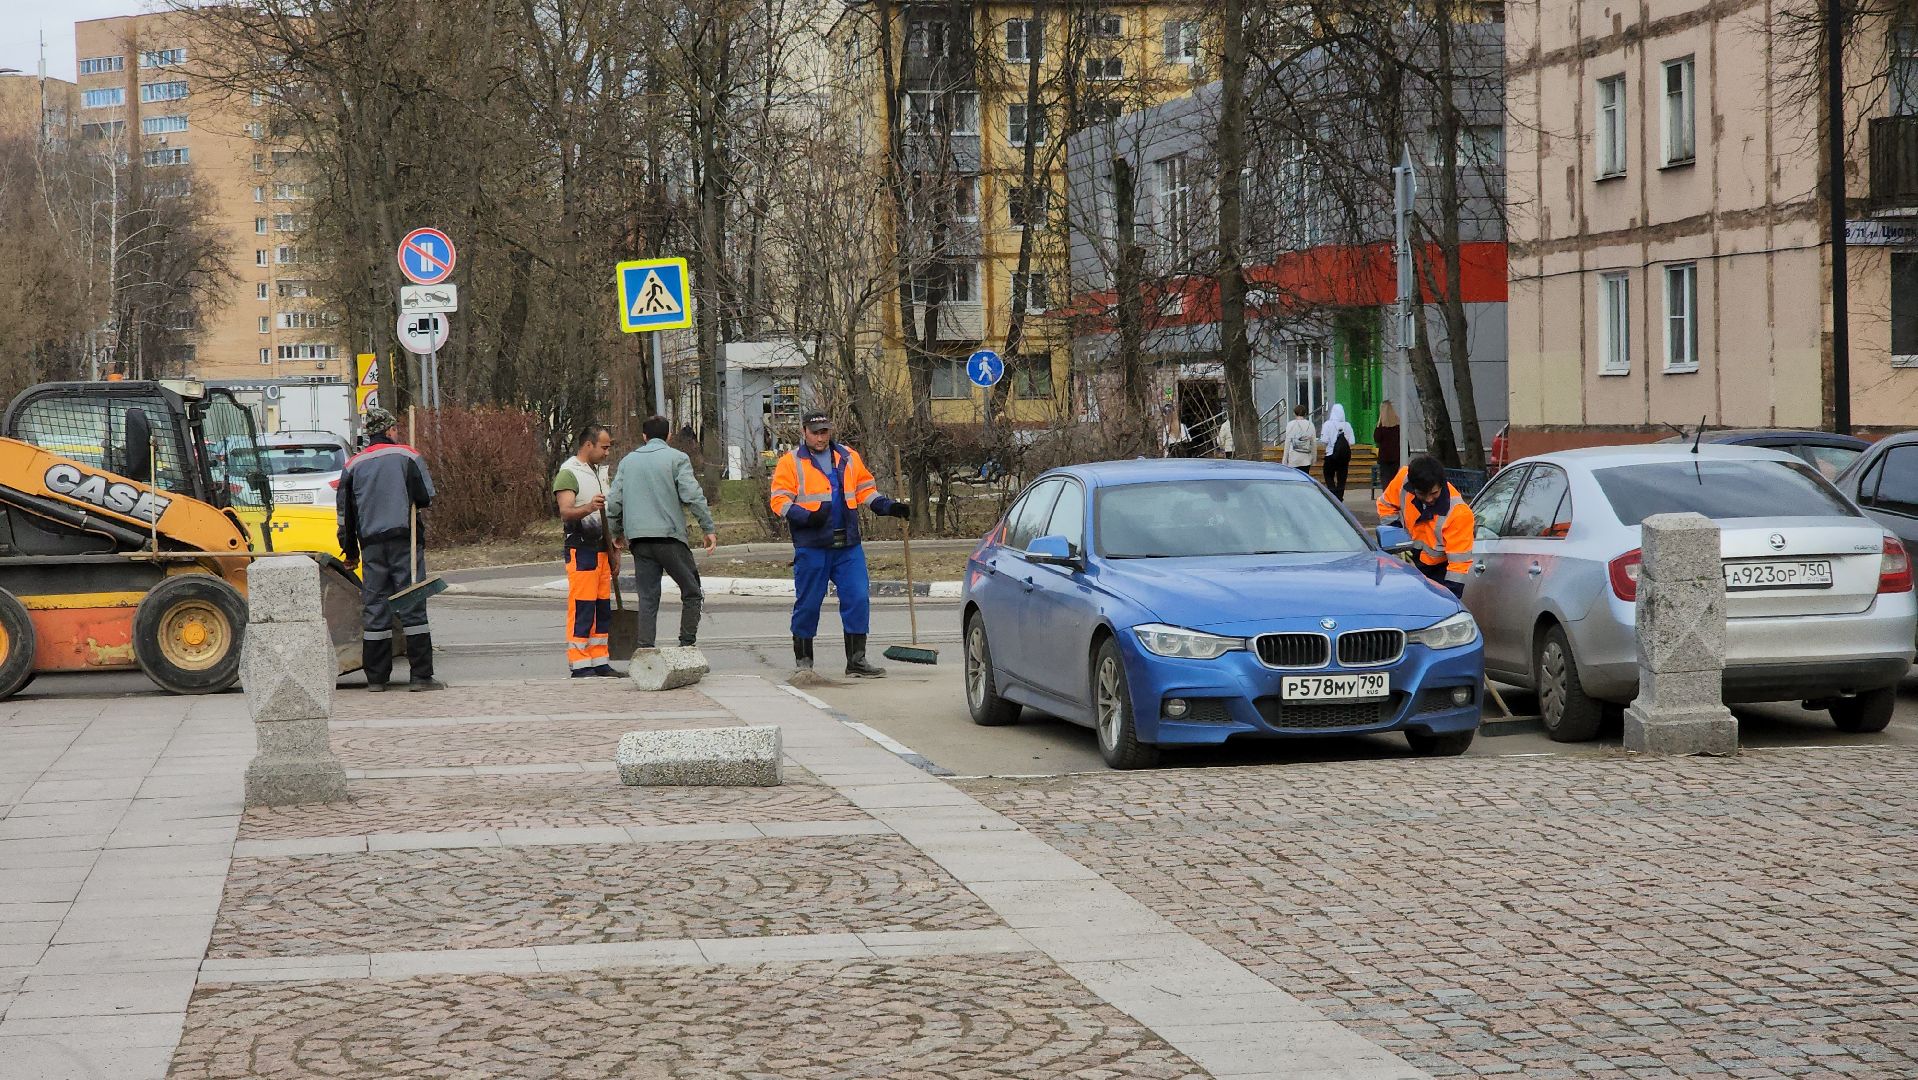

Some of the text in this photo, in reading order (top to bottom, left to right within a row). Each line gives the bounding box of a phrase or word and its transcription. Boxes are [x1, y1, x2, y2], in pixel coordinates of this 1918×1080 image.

[45, 463, 172, 523] CASE
[1732, 563, 1825, 585] А923ОР 750
[1288, 675, 1384, 697] Р578МУ 790
